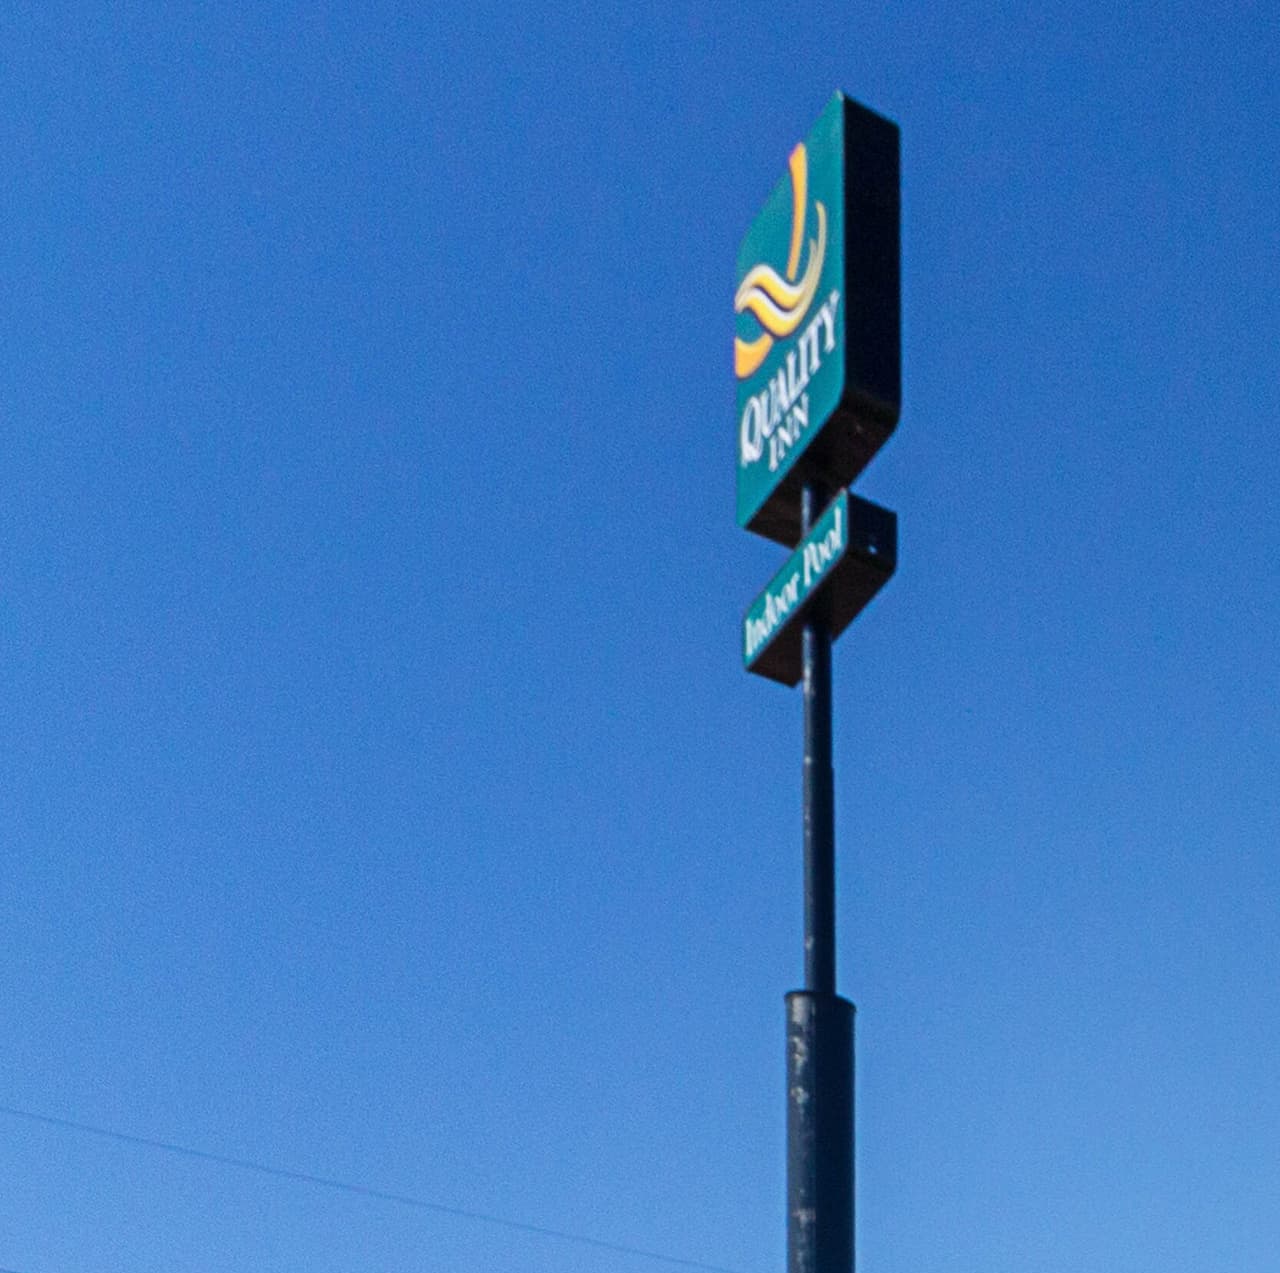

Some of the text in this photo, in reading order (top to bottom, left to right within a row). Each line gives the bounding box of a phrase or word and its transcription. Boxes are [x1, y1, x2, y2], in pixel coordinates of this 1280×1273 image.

[740, 290, 839, 467] QUALITY
[769, 392, 808, 471] INN
[745, 506, 842, 656] Indoor Pool
